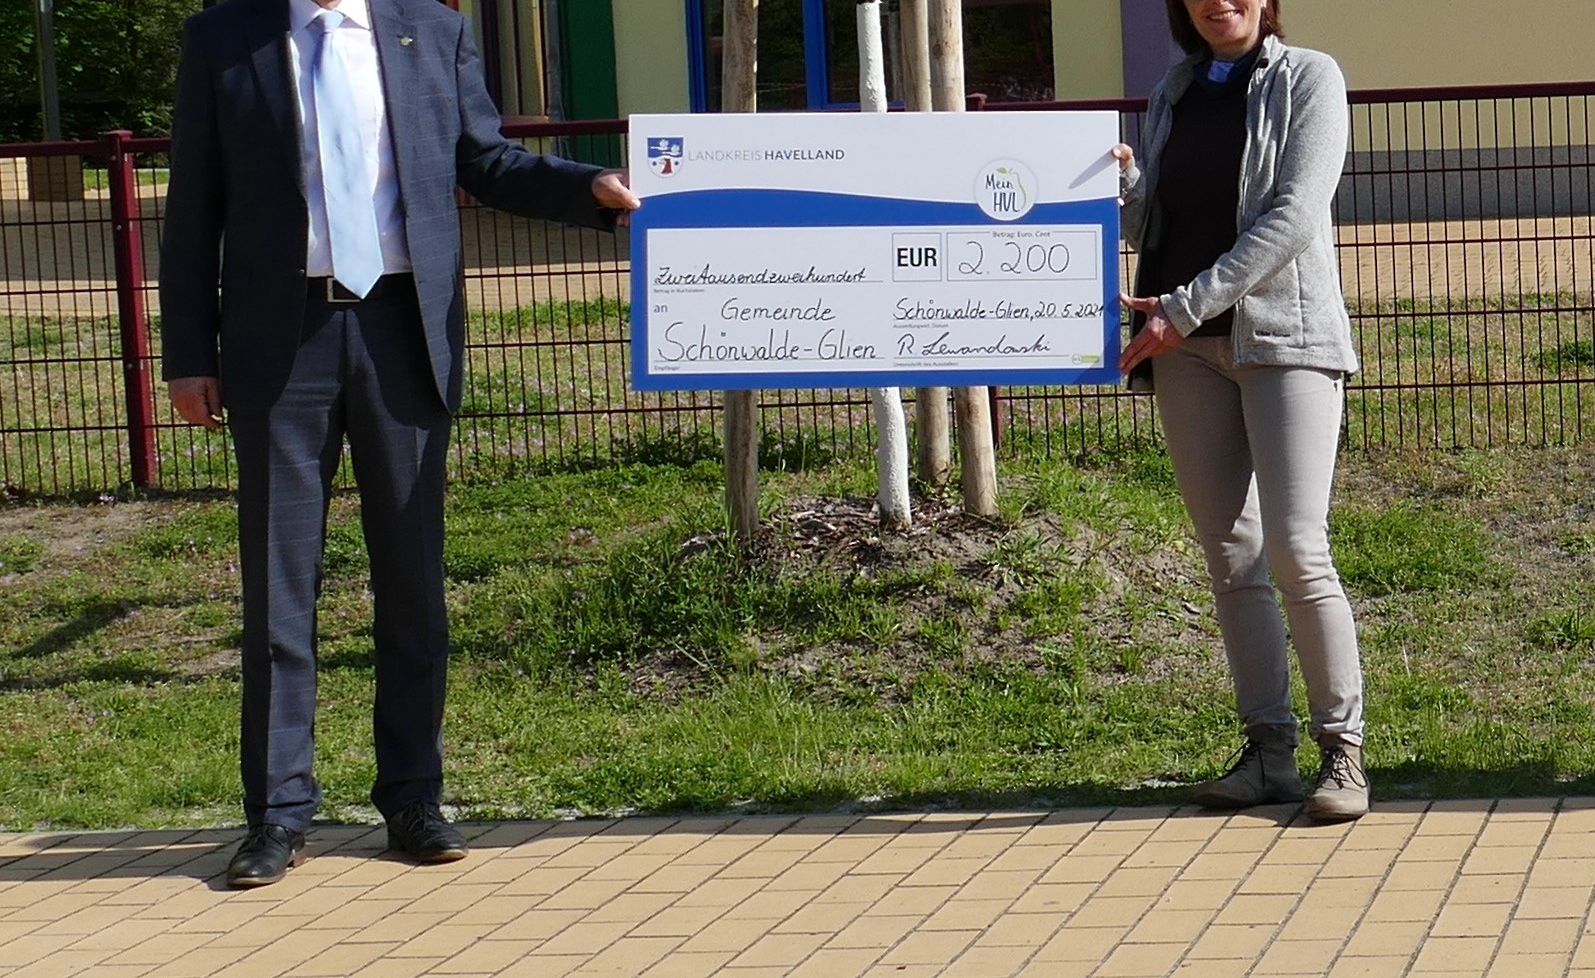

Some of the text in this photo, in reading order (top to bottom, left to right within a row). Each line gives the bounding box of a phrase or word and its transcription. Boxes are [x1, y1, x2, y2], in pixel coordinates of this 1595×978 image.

[688, 149, 845, 161] LANDKREIS HAVELLAND
[985, 173, 1014, 190] Mein
[993, 191, 1021, 212] HVL
[897, 247, 937, 268] EUR
[653, 304, 668, 313] an
[721, 297, 836, 321] Gemeinde
[657, 322, 877, 361] Schönwalde-Glien
